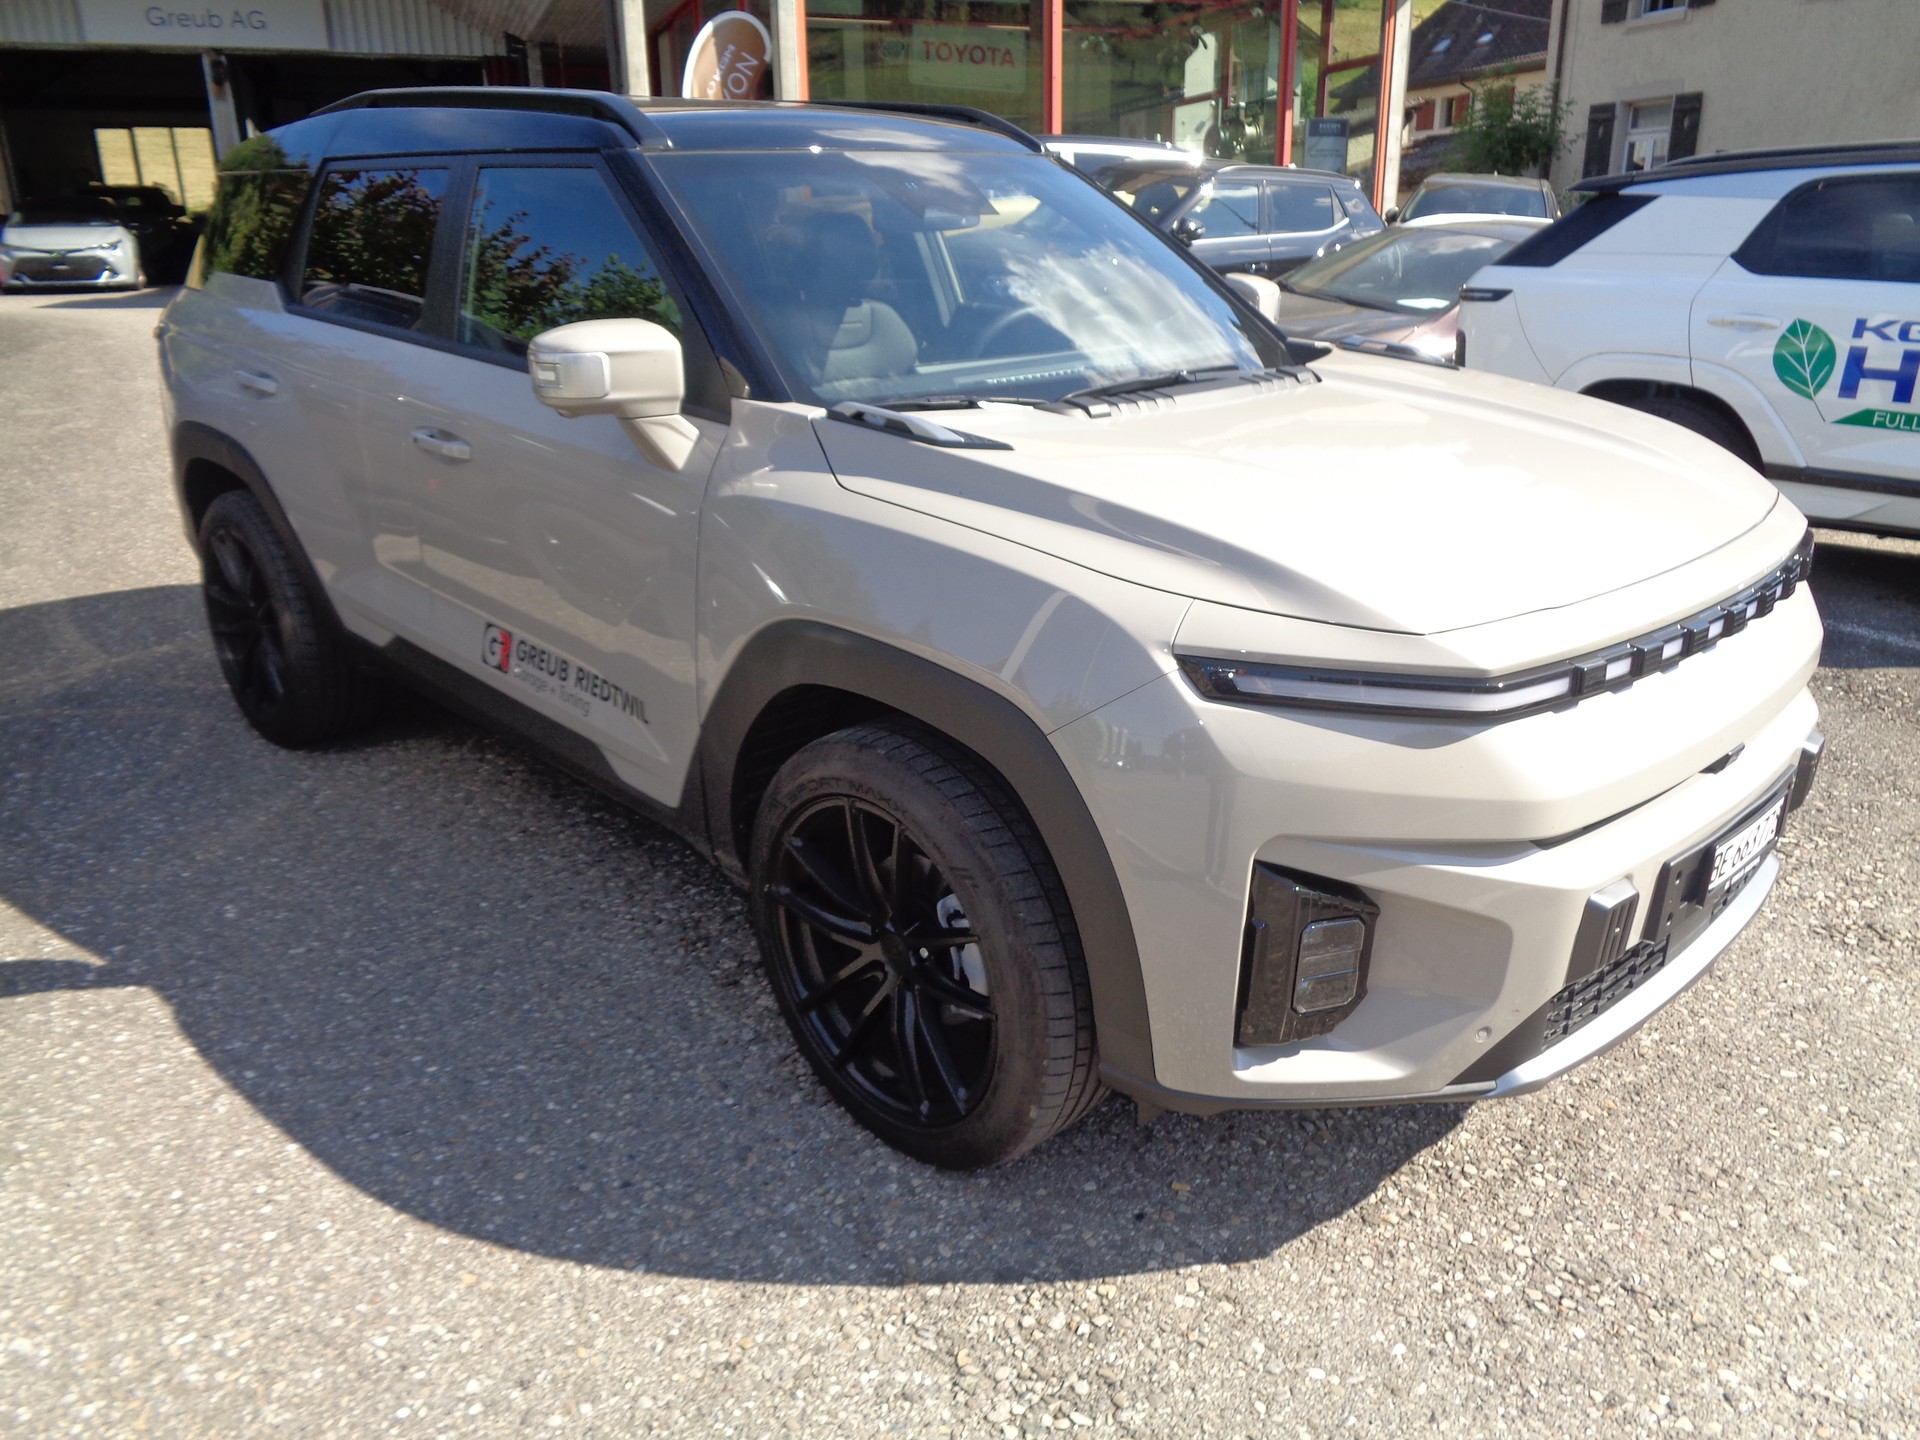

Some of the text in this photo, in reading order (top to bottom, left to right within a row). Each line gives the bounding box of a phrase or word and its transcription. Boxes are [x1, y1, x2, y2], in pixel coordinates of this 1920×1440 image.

[145, 6, 267, 30] Greub AG
[922, 40, 1016, 68] TOYOTA
[1873, 411, 1920, 431] FULL
[517, 639, 649, 724] GREUB RIEDTWIL
[559, 684, 592, 717] Tuning
